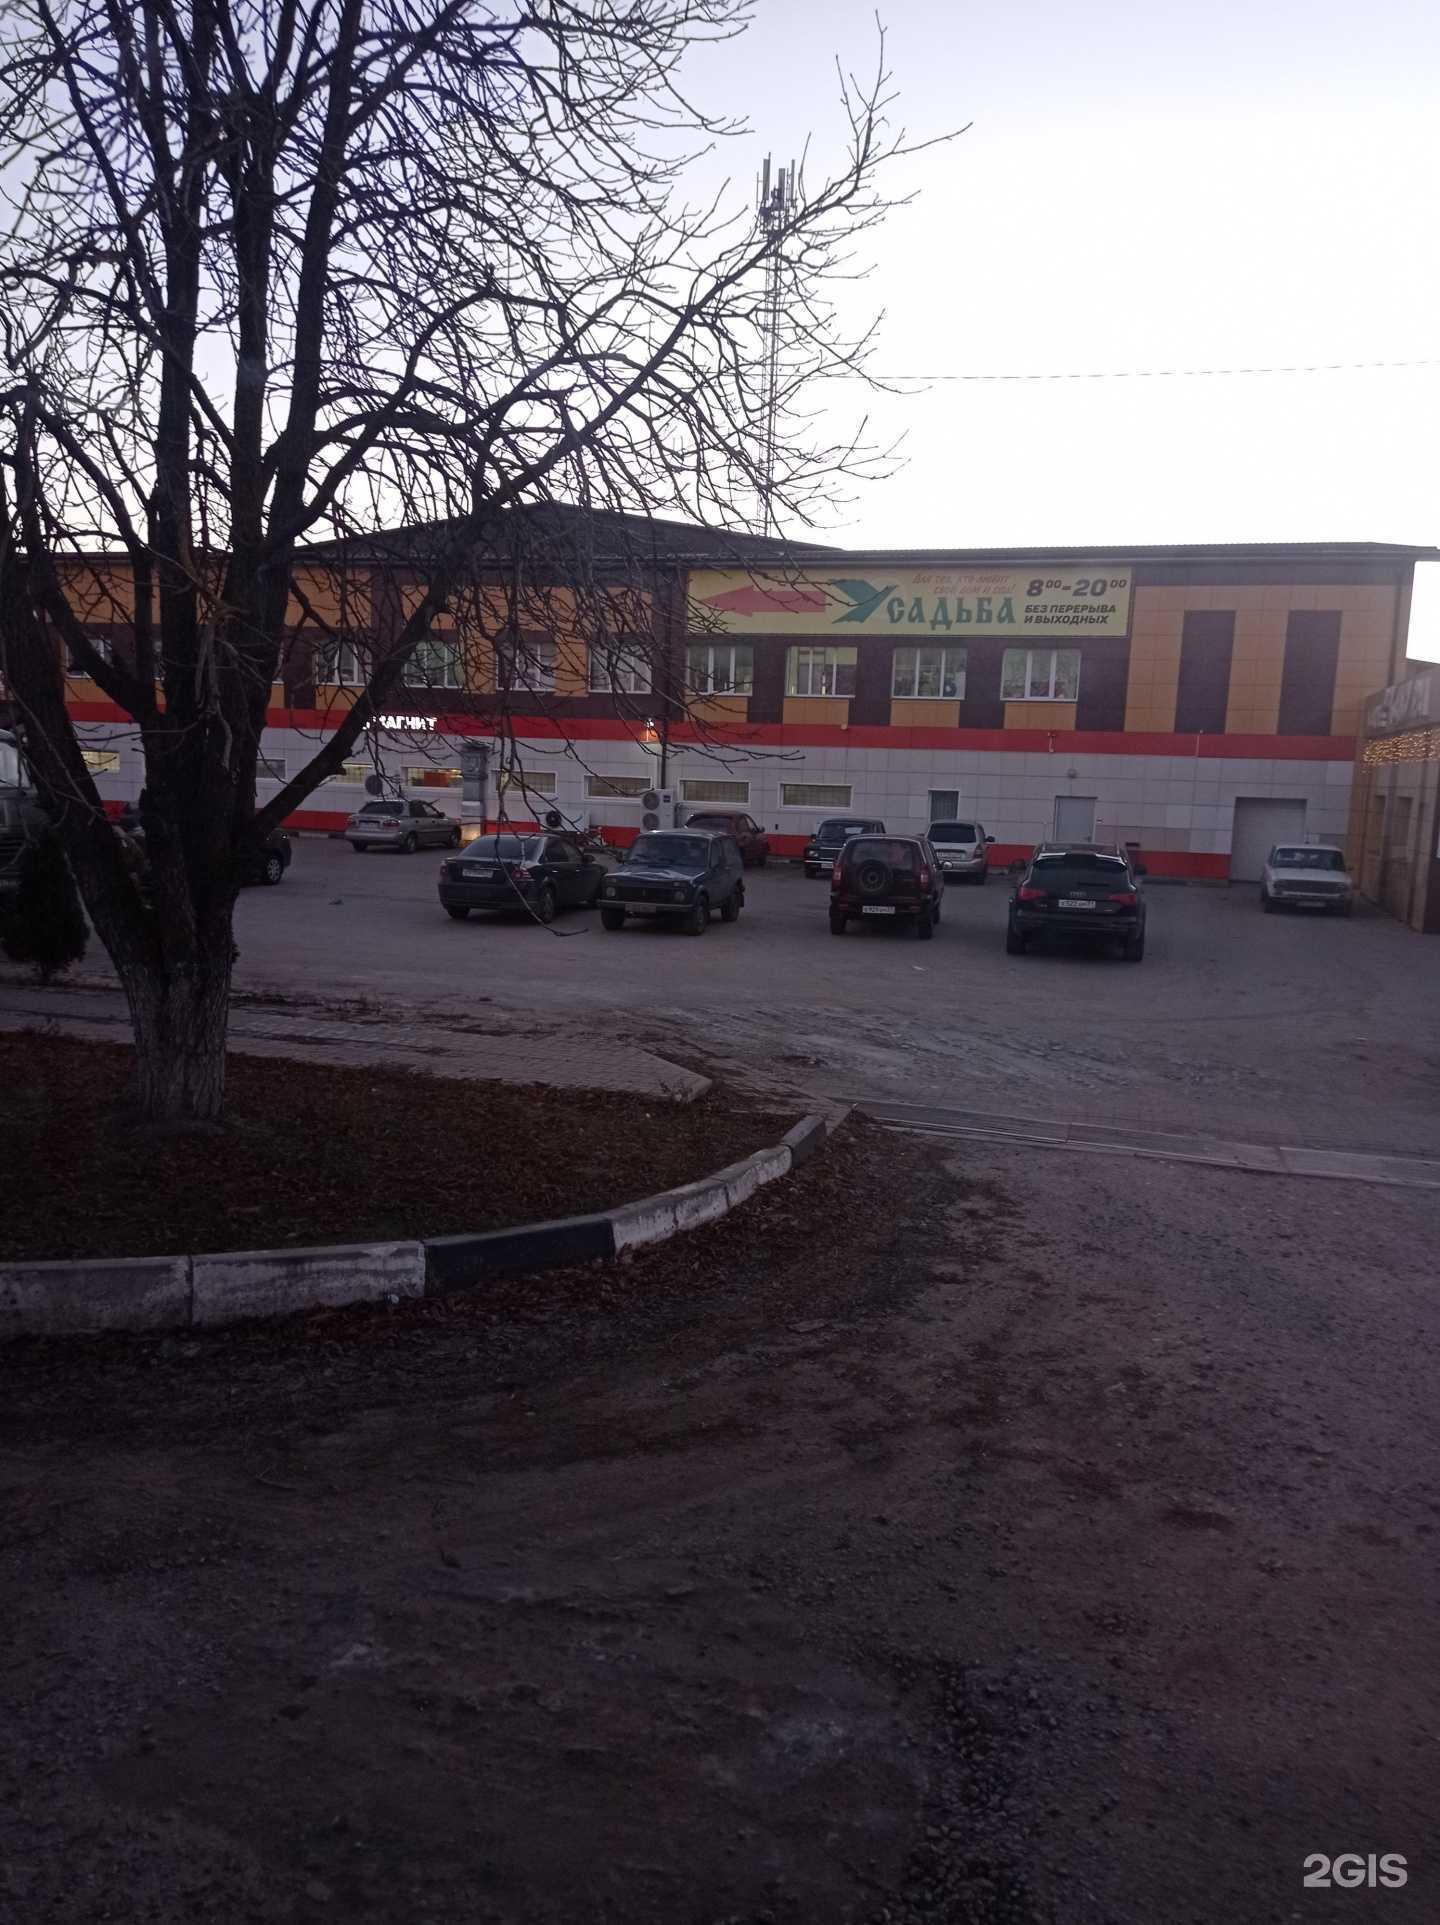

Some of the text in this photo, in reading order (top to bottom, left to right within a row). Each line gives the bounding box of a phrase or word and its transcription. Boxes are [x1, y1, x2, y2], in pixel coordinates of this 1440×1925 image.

[1024, 604, 1117, 614] БЕЗ ПЕРЕРЫВА
[1035, 615, 1110, 626] ВЫХОДНЫХ
